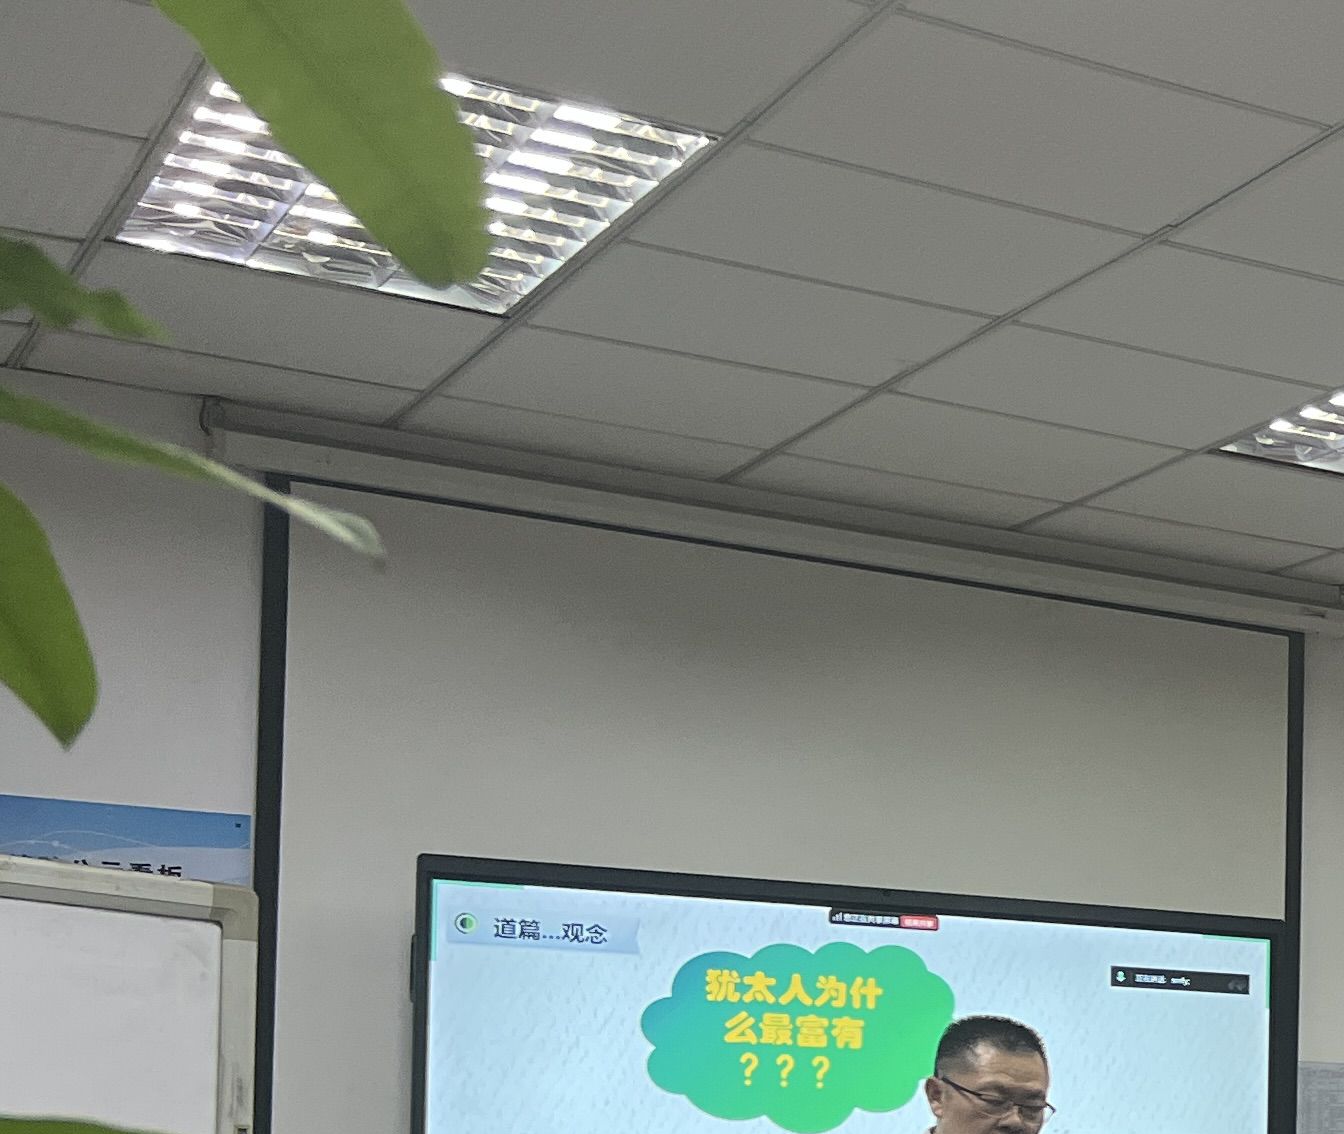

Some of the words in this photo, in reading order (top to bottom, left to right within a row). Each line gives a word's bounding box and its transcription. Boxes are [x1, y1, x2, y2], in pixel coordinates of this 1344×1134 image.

[705, 969, 884, 1009] 犹太人为什
[723, 1012, 865, 1051] 么最富有
